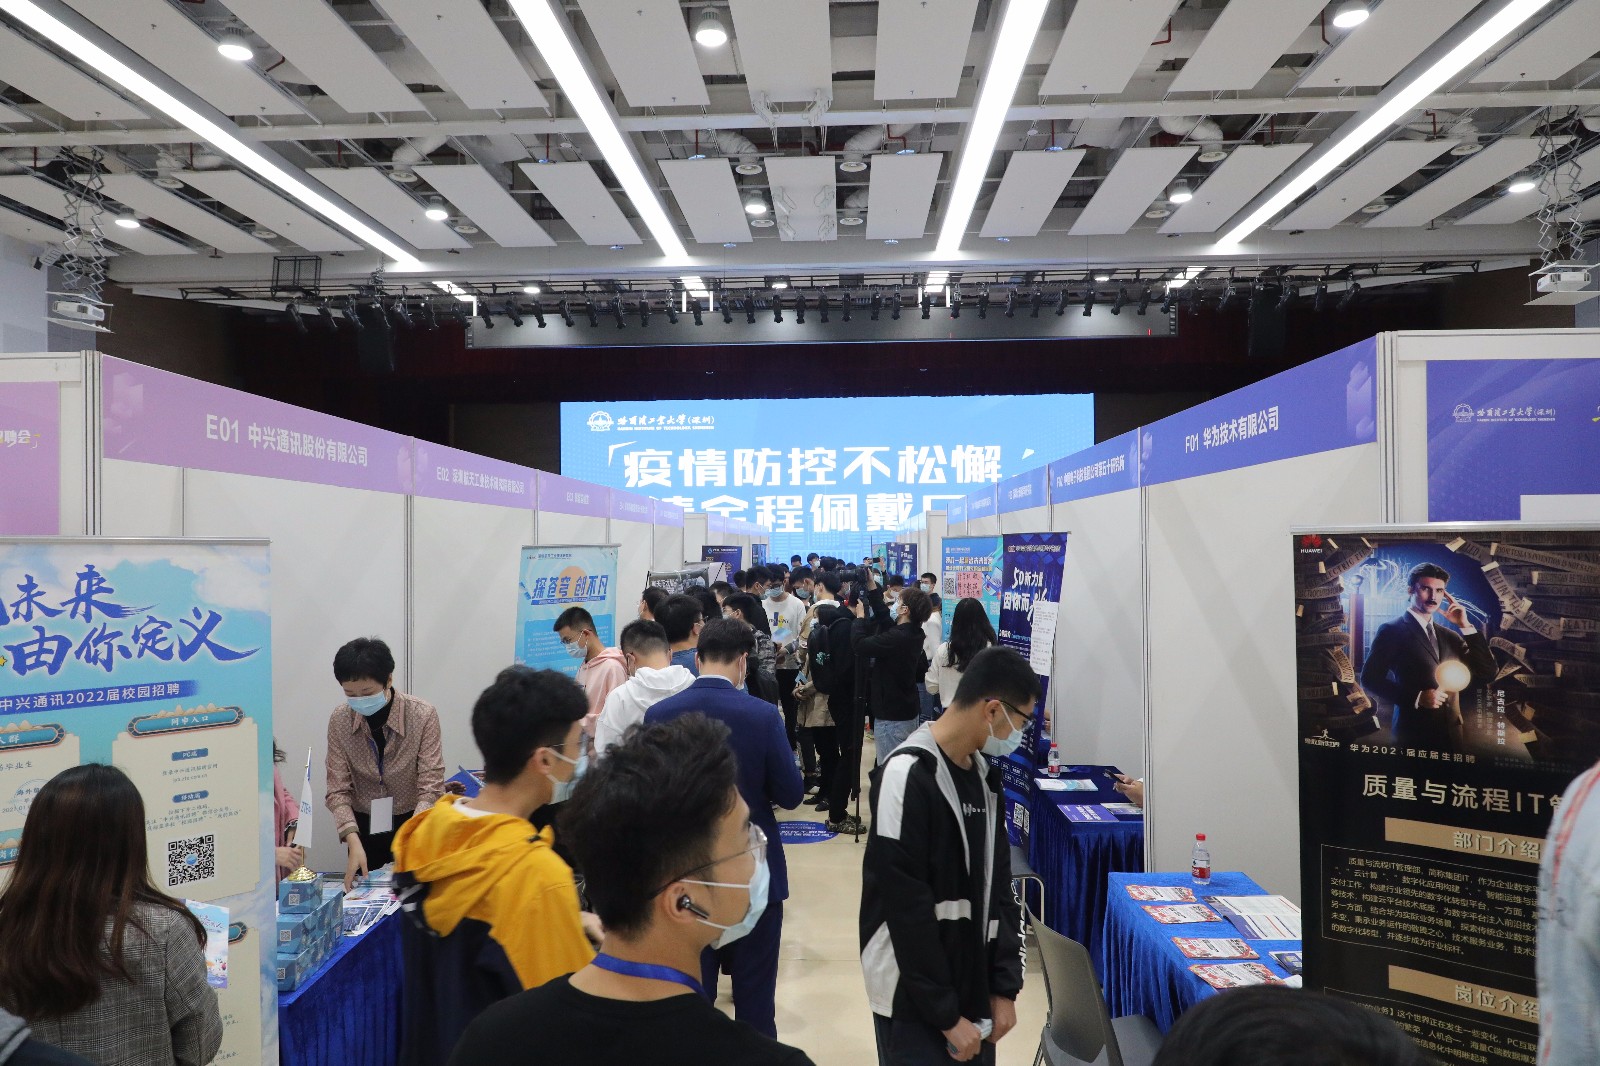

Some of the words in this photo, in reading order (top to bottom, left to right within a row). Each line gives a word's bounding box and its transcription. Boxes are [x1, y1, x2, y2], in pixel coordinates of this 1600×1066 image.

[0, 429, 31, 448] 聘会
[206, 413, 239, 443] E01
[248, 422, 368, 467] 中兴通讯股份有限公司
[1185, 432, 1199, 454] F01
[1203, 405, 1279, 449] 华为技术有限公司
[436, 466, 449, 482] E02
[624, 444, 1003, 488] 疫情防控不松懈
[0, 564, 159, 625] 未来
[532, 575, 571, 599] 探苍穹
[574, 574, 609, 597] 创不凡
[3, 606, 262, 676] 由你定义
[0, 683, 180, 711] 中兴通讯2022届校园招聘
[1350, 743, 1476, 764] 华为202届应届生招聘
[1453, 831, 1540, 860] 部门介绍
[1455, 984, 1540, 1019] 岗位介绍
